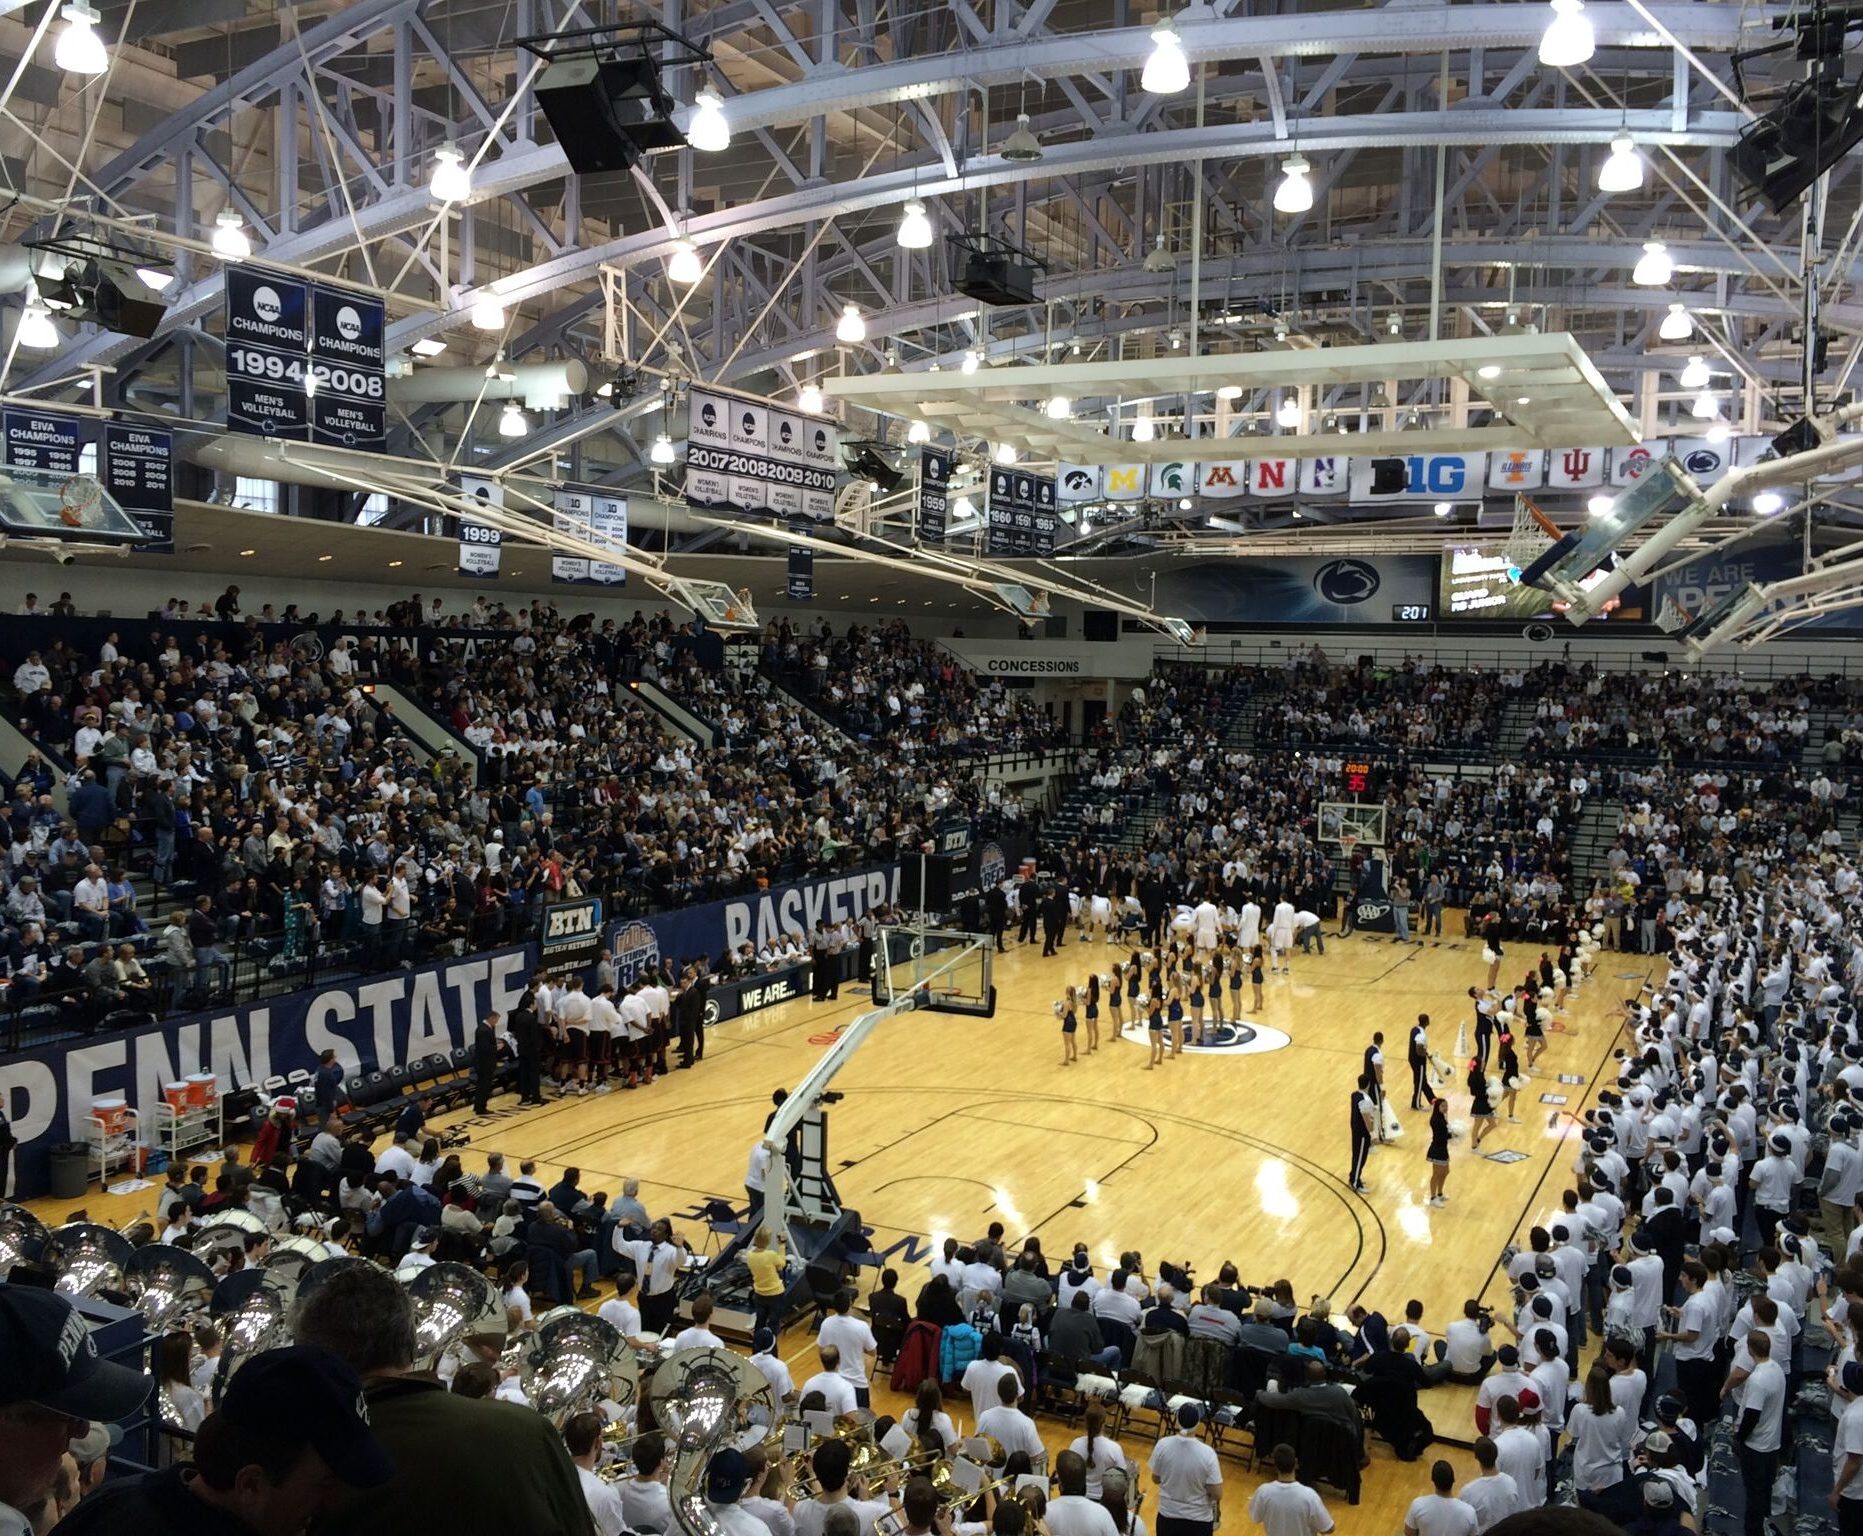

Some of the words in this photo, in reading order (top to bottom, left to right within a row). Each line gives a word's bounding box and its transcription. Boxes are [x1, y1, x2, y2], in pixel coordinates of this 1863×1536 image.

[257, 301, 280, 314] NCAA
[233, 317, 303, 341] CHAMPIONS
[340, 321, 361, 333] NCAA
[319, 336, 381, 358] CHAMPIONS
[231, 349, 304, 382] 1994
[314, 365, 383, 397] 2008
[254, 393, 284, 407] MEN'S
[241, 401, 297, 419] VOLLEYBALL
[337, 408, 364, 420] MEN'S
[30, 420, 56, 433] EIVA
[324, 415, 376, 432] VOLLEYBALL
[9, 429, 75, 445] CHAMPIONS
[128, 433, 151, 444] EIVA
[109, 441, 169, 457] CHAMPIONS
[688, 447, 730, 466] 2007
[728, 456, 768, 476] 2008
[767, 465, 804, 484] 2009
[1258, 461, 1286, 489] N
[1500, 461, 1533, 473] ILLINOIS
[113, 478, 136, 488] 2010
[804, 471, 835, 489] 2010
[1108, 467, 1138, 492] M
[1205, 467, 1237, 487] M
[922, 494, 946, 512] 1959
[990, 509, 1012, 525] 1960
[463, 526, 500, 544] 1999
[1664, 567, 1700, 585] WE
[1707, 562, 1756, 584] ARE
[988, 658, 1080, 674] CONCESSIONS
[1345, 763, 1369, 774] 20:00
[1348, 774, 1366, 792] 35
[548, 905, 594, 937] BTN
[613, 946, 648, 967] RETURN
[546, 959, 592, 974] www.BTN.com
[742, 989, 762, 1011] WE
[763, 980, 796, 1007] ARE...
[0, 1007, 271, 1199] PENN
[305, 951, 525, 1088] STATE
